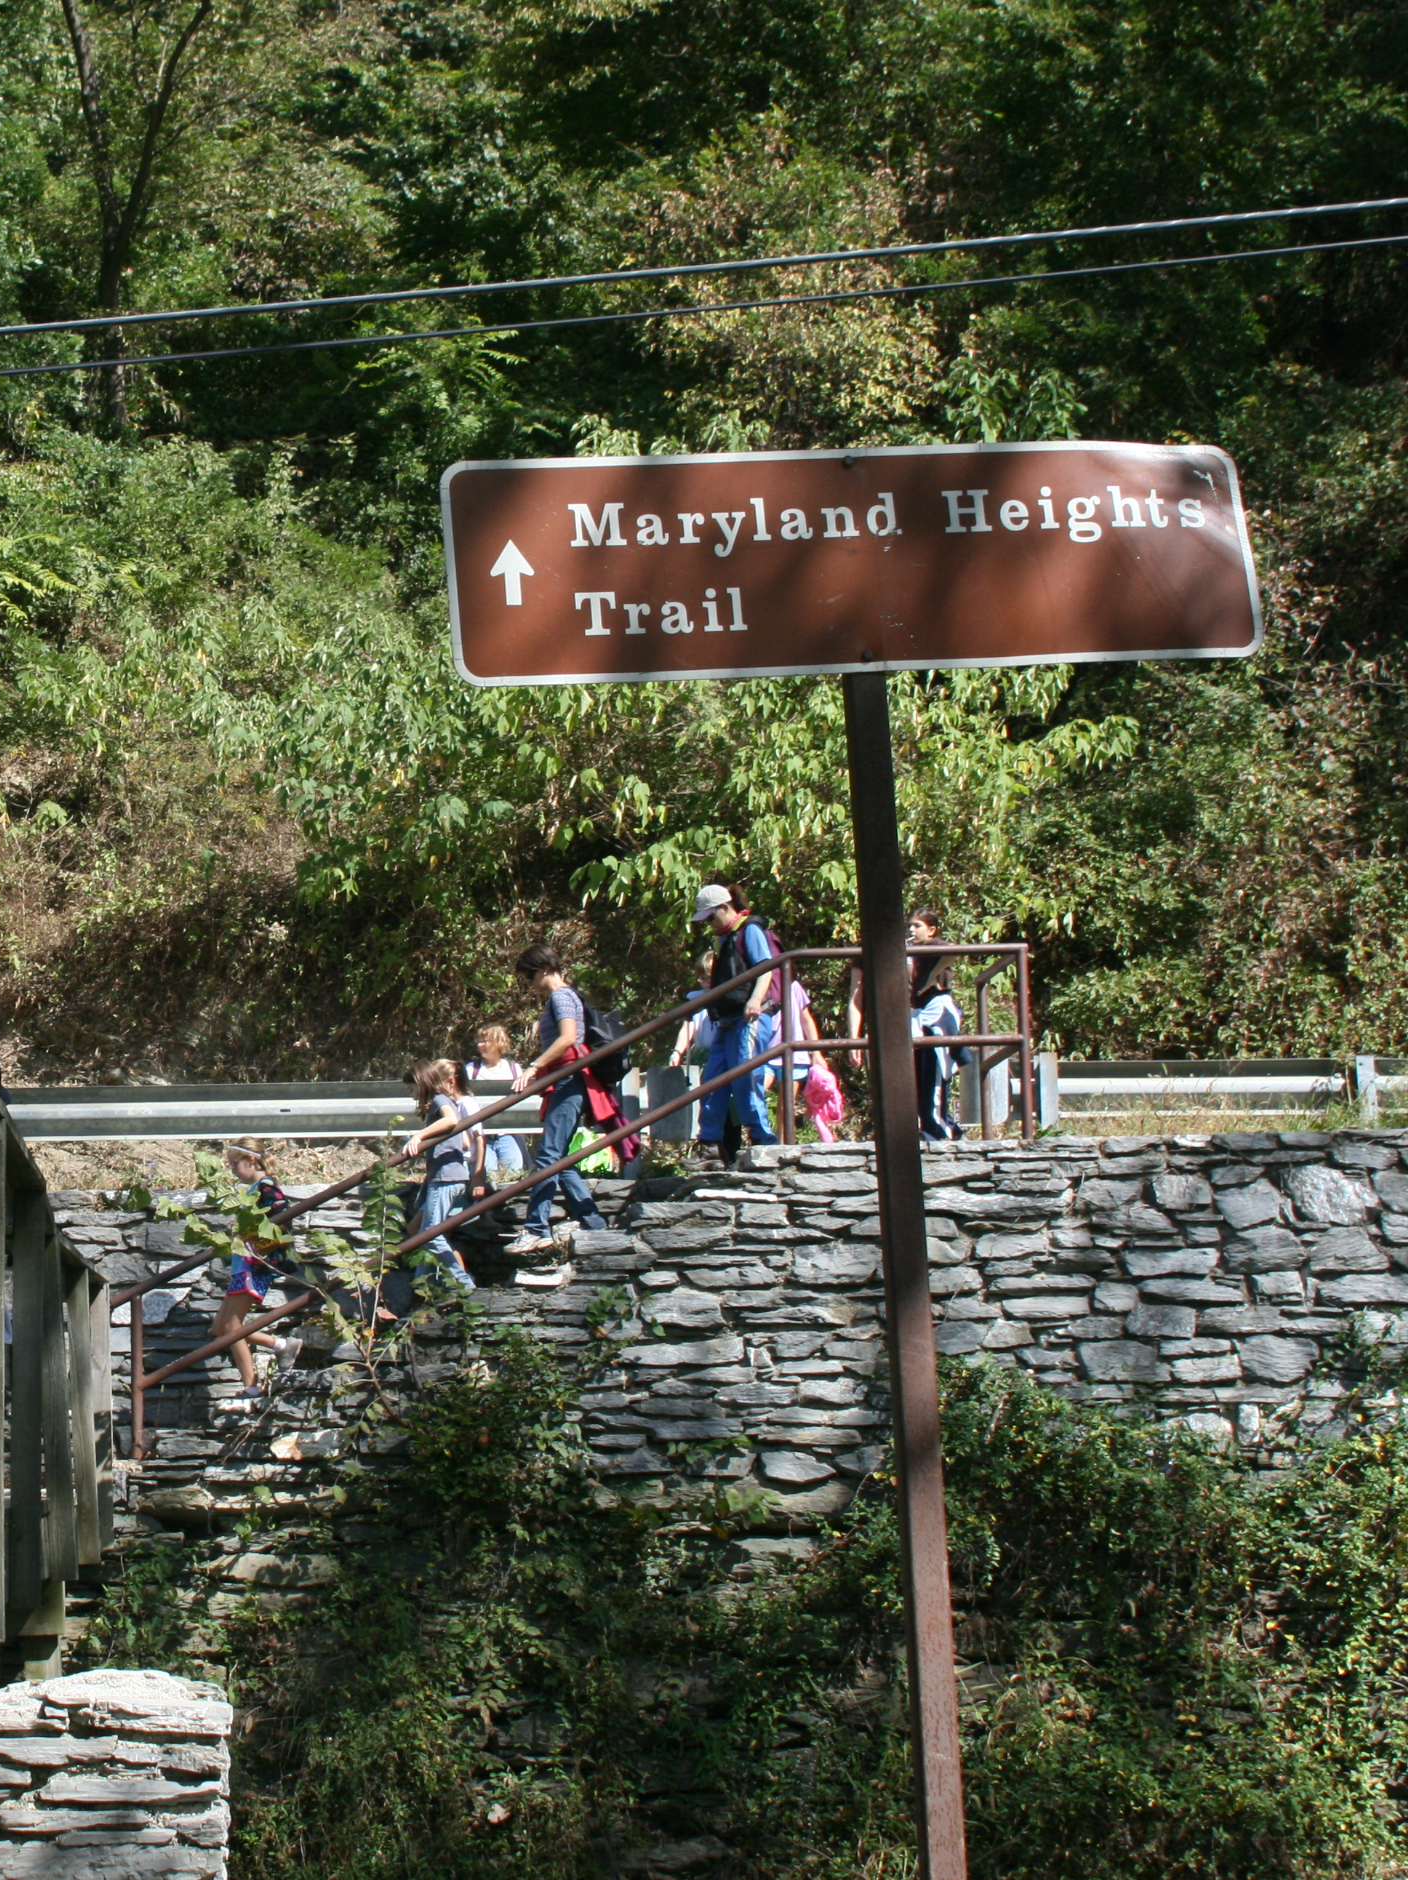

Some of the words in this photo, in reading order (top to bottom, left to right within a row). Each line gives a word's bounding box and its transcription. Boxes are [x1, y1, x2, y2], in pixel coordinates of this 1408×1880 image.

[568, 492, 901, 557] Maryland
[942, 486, 1206, 542] Heights
[574, 587, 748, 637] Trail
